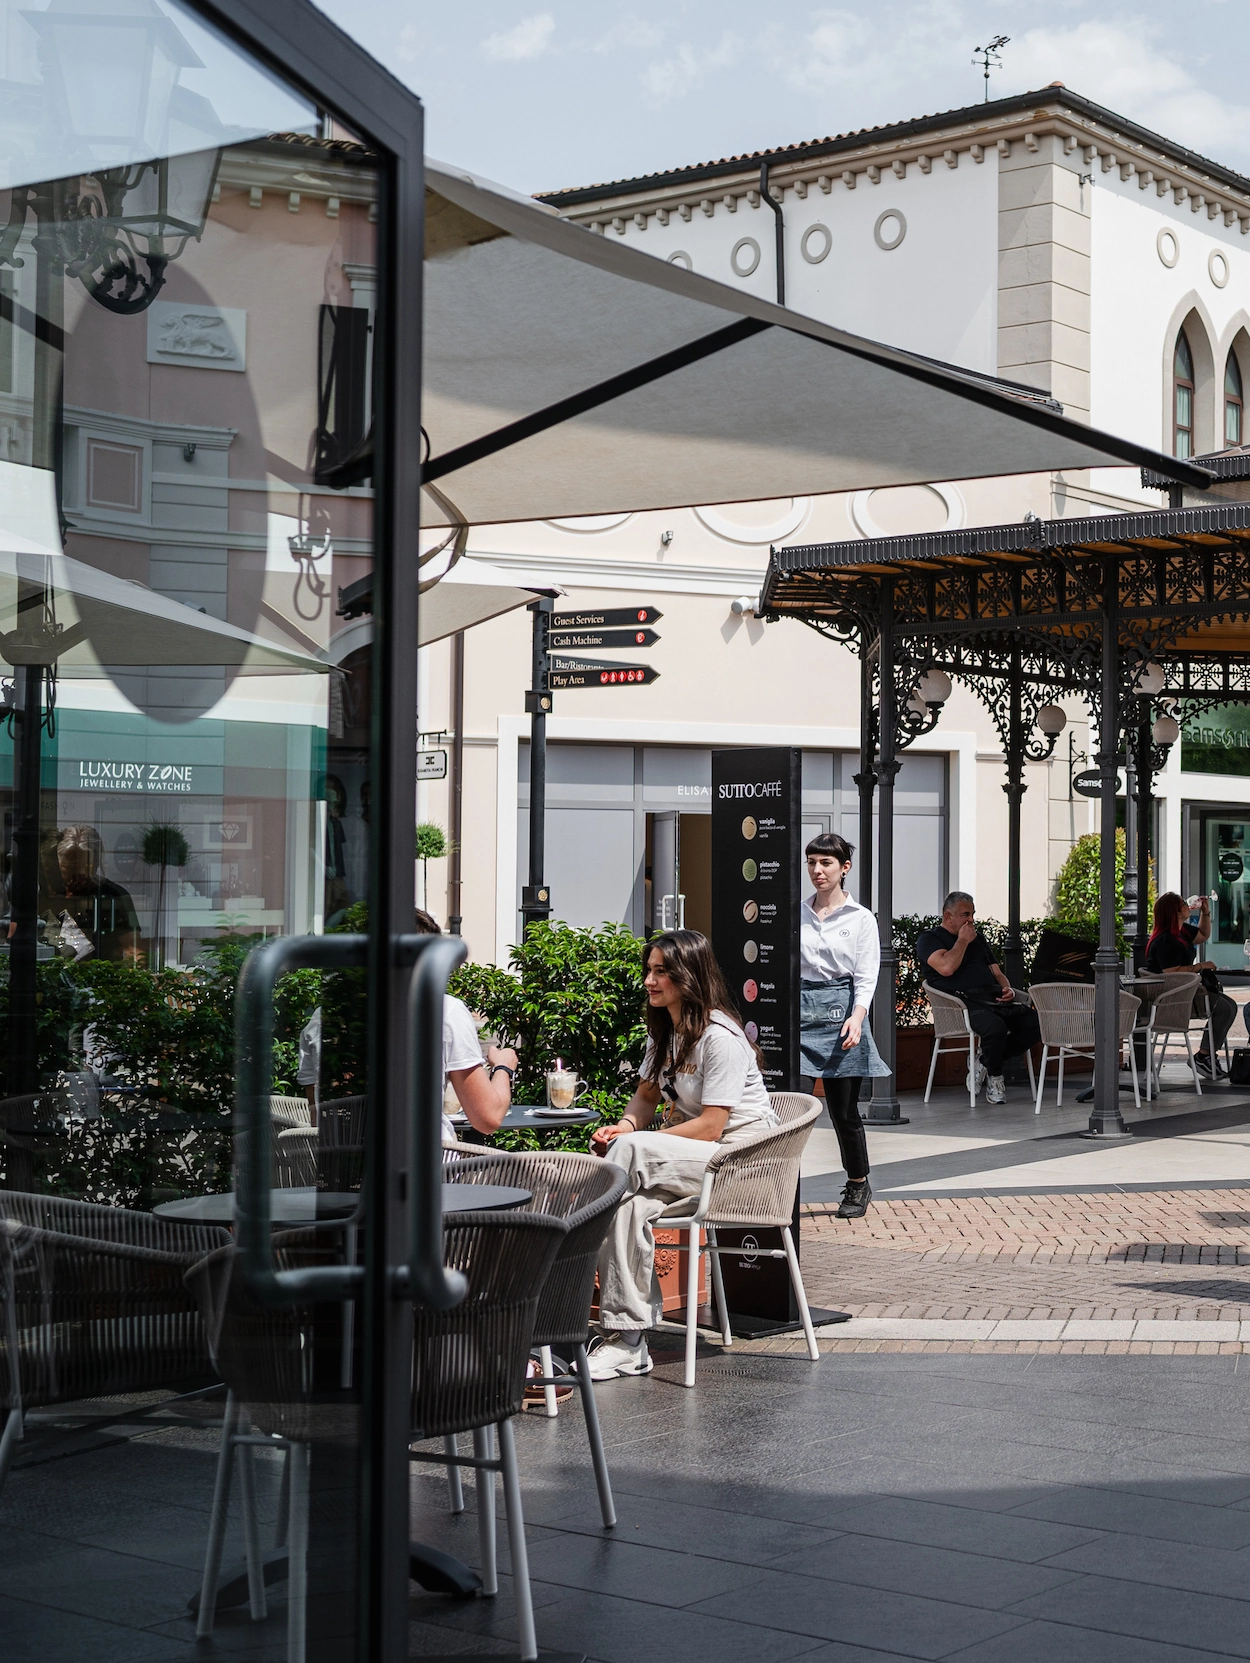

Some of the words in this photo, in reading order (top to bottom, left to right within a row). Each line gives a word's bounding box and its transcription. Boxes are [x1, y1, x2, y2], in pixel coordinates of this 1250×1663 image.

[554, 616, 575, 627] Guest
[576, 614, 605, 625] Services
[553, 636, 571, 646] Cash
[572, 635, 603, 646] Machine
[553, 676, 568, 687] Play
[569, 675, 585, 685] Area
[79, 761, 145, 780] LUXURY
[148, 764, 193, 782] ZONE
[79, 778, 133, 789] JEWELLERY
[136, 780, 144, 789] &
[146, 781, 192, 792] WATCHES
[677, 785, 713, 796] ELISA
